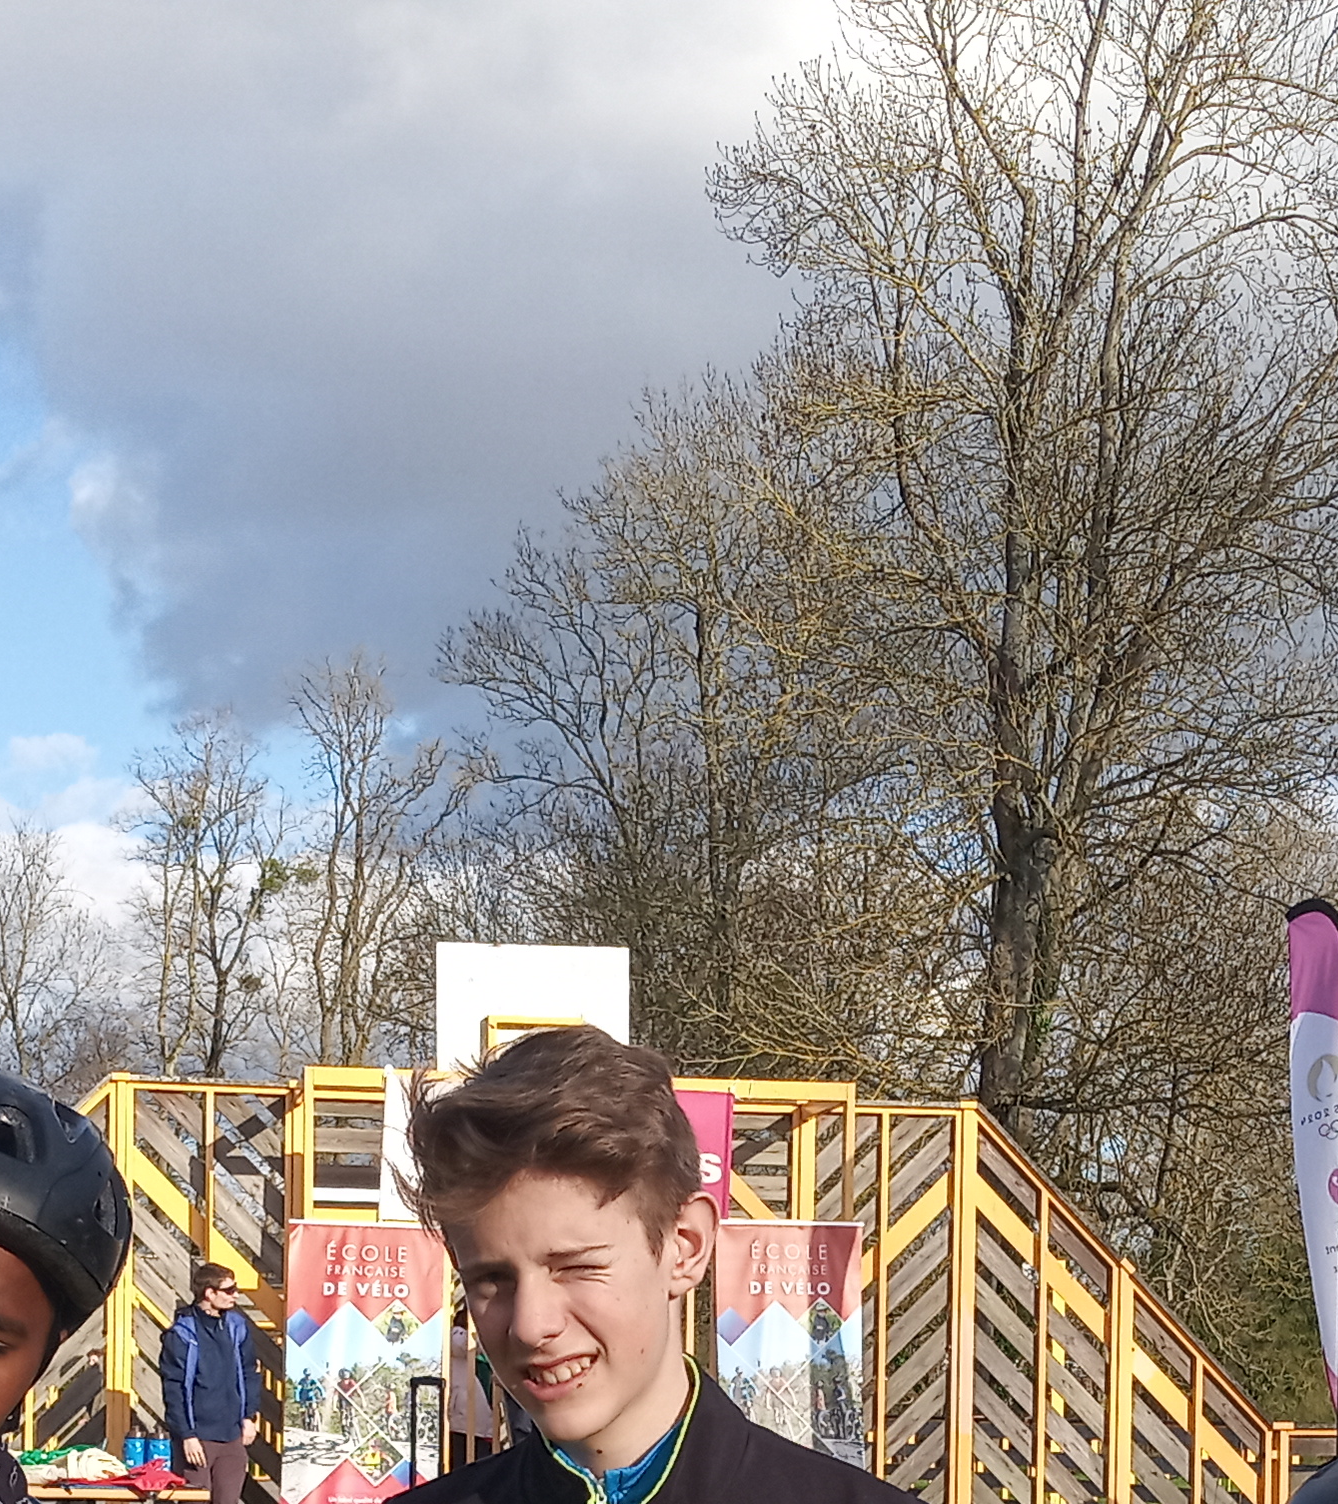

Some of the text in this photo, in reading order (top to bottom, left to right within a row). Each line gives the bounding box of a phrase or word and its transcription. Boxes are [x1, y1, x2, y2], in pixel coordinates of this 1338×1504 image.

[326, 1240, 408, 1263] ÉCOLE
[750, 1239, 828, 1260] ÉCOLE
[326, 1264, 406, 1278] FRANÇAISE
[752, 1264, 828, 1276] FRANÇAISE
[322, 1279, 410, 1298] DE VÉLO
[749, 1278, 831, 1296] DE VÉLO
